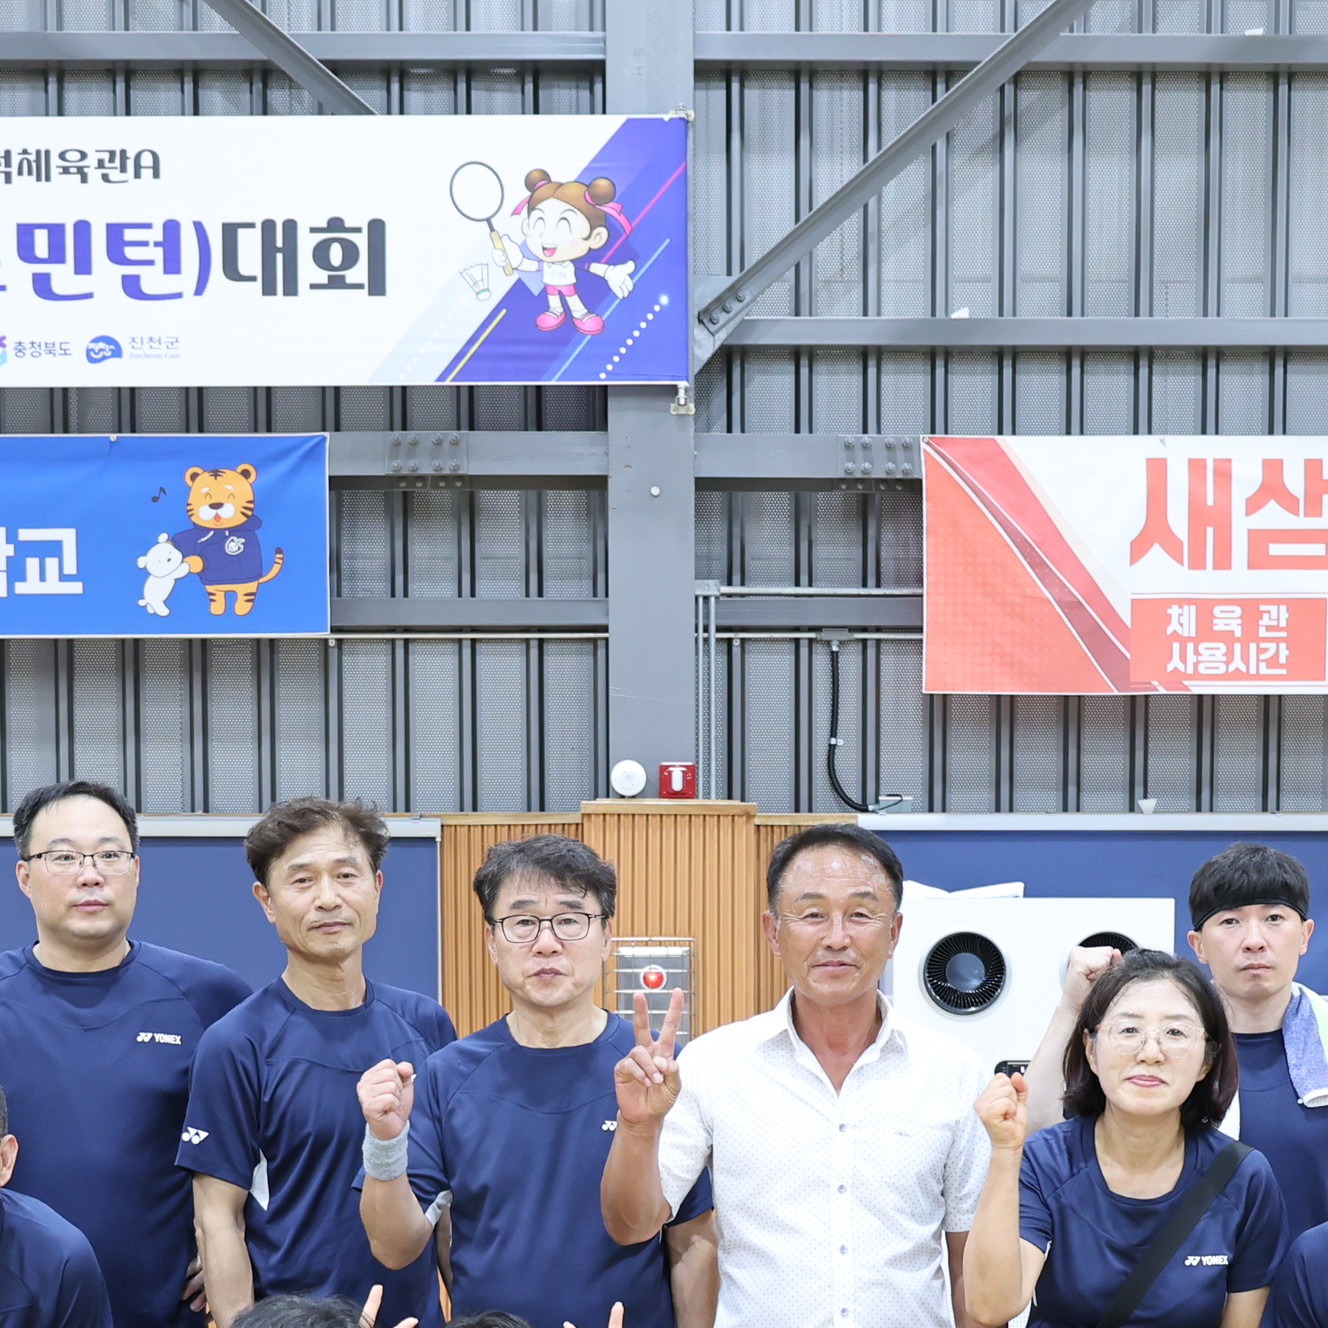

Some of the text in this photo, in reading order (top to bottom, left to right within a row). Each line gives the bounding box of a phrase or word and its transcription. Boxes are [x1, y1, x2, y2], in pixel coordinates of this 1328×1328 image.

[12, 340, 73, 359] 충청북도
[128, 335, 181, 350] 진천군
[1166, 641, 1291, 675] 사용시간
[153, 1033, 182, 1045] YONEX
[1201, 1255, 1229, 1267] YONEX
